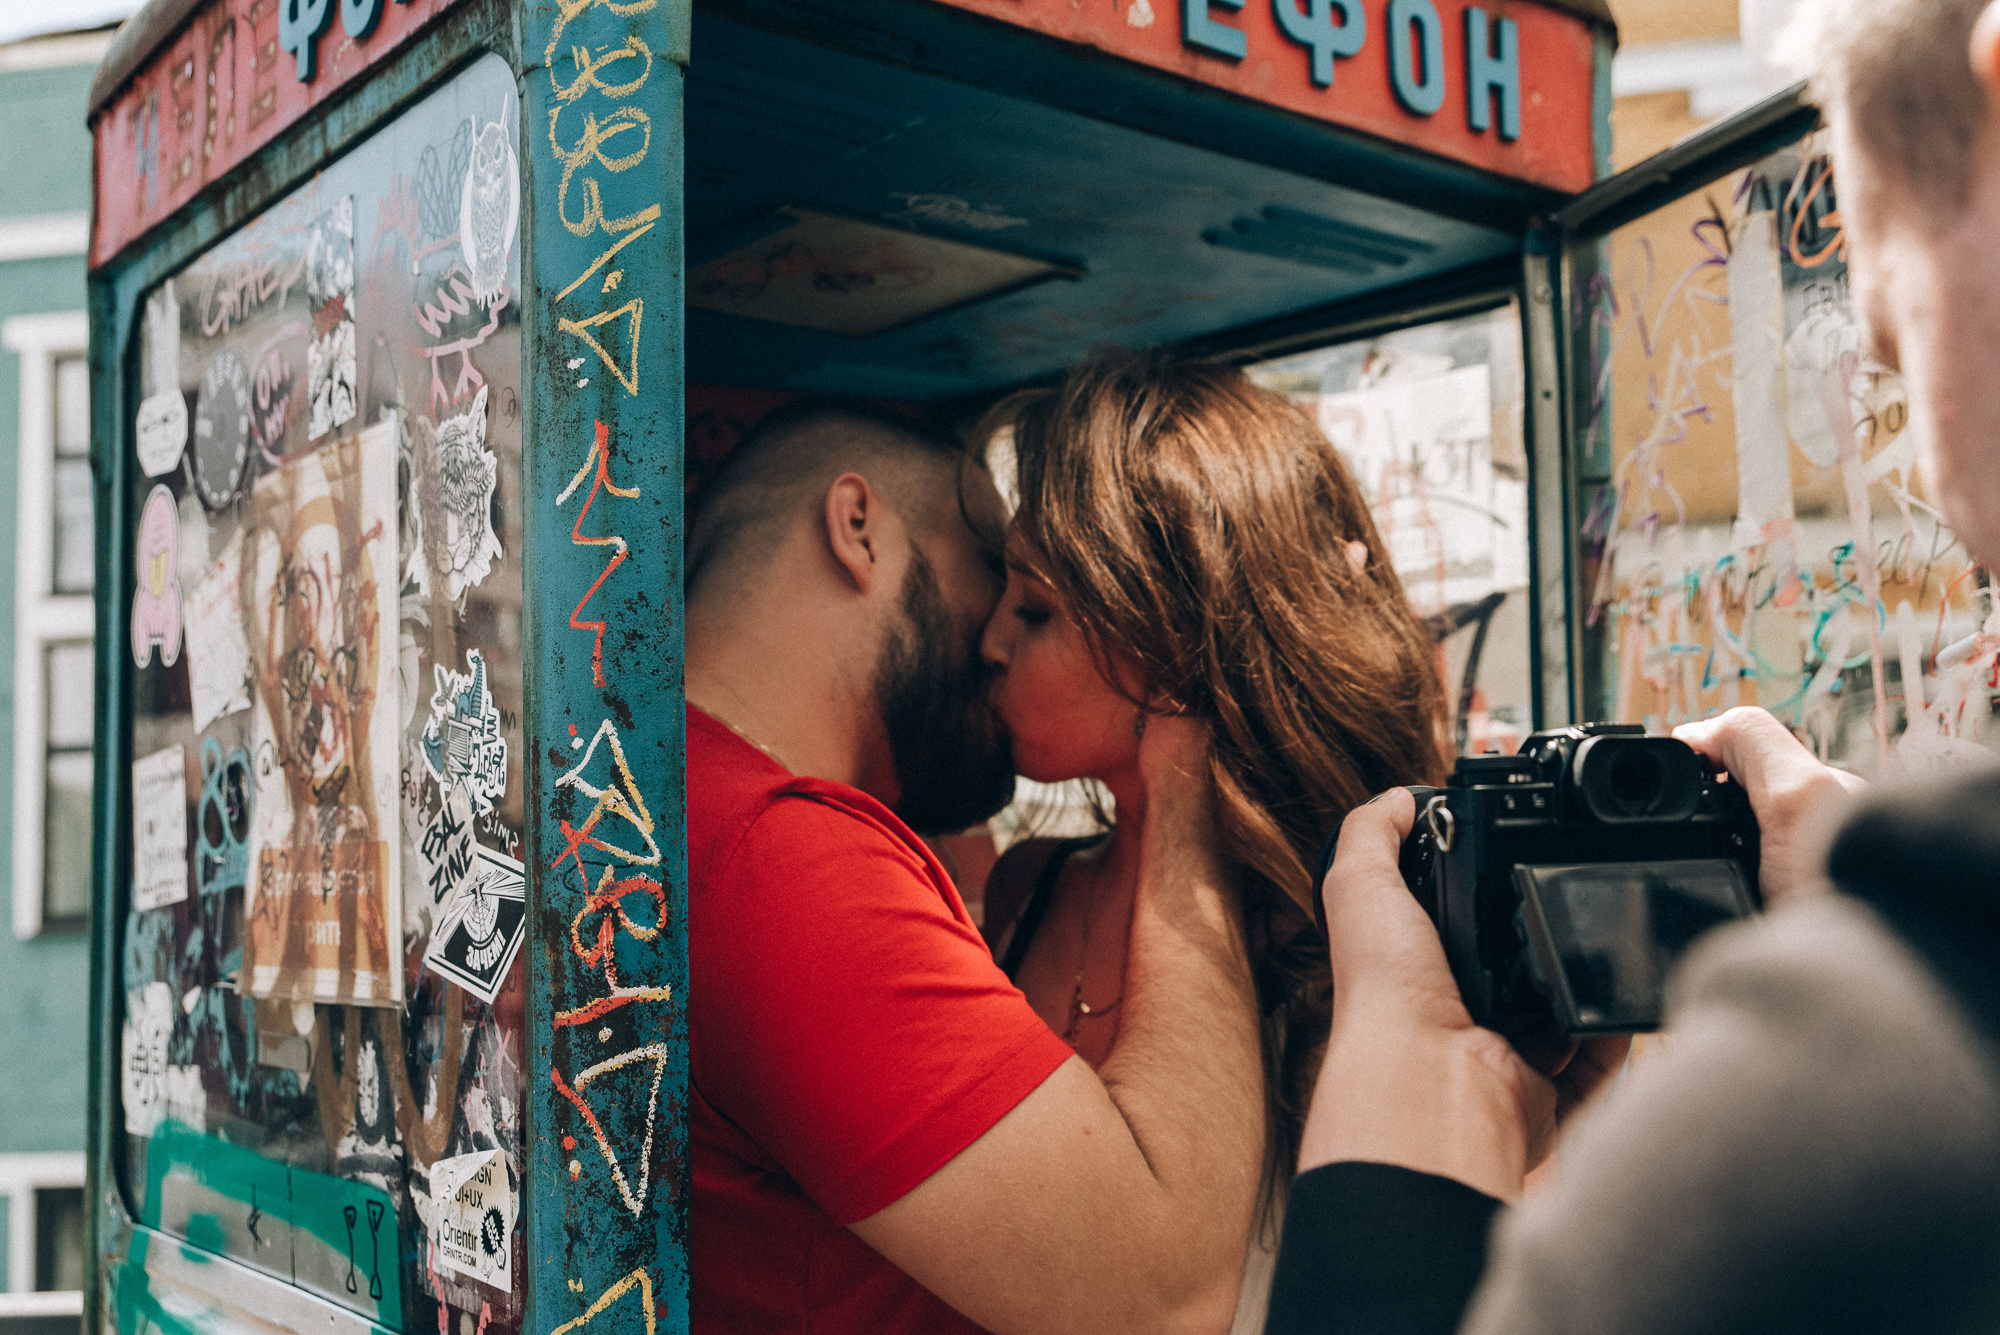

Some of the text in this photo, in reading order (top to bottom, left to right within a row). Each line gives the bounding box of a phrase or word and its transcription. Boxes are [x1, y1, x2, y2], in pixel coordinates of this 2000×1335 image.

[429, 833, 473, 904] ZINE
[442, 1218, 477, 1252] Orientir
[443, 1245, 477, 1268] ORNTR.COM
